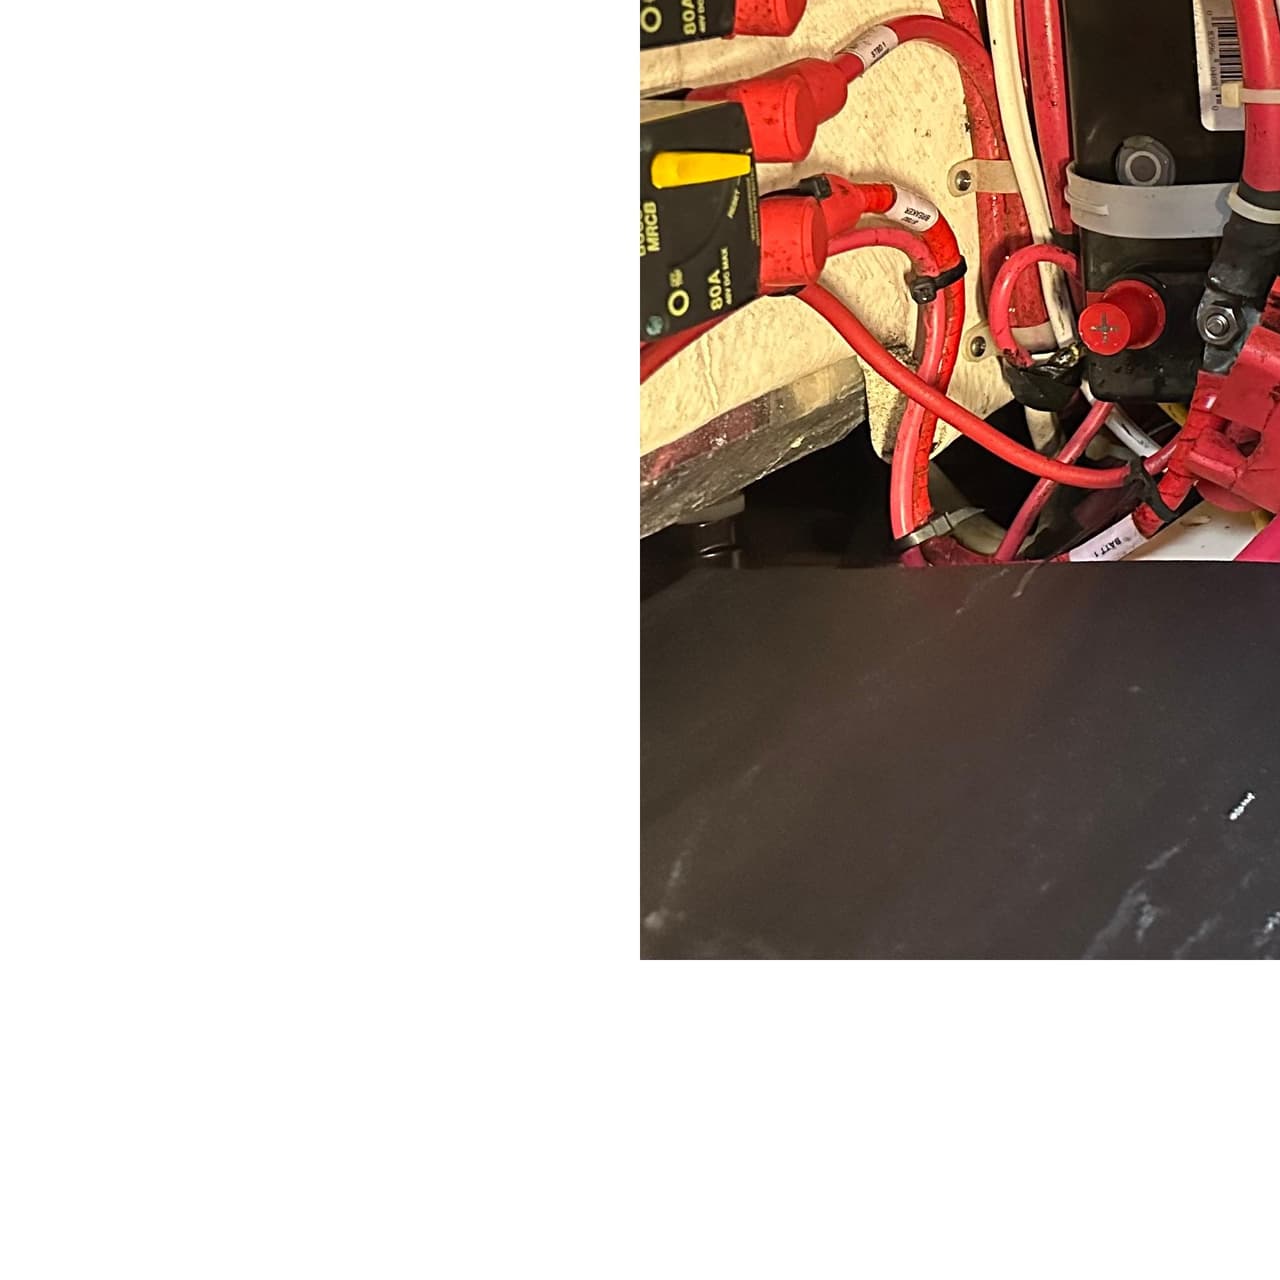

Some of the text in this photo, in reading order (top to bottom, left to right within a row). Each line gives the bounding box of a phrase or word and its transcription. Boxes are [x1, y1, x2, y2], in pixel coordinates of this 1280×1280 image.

[644, 201, 660, 251] MRCB
[721, 247, 729, 269] MAX
[708, 270, 723, 310] 80A
[1101, 537, 1121, 555] BATT
